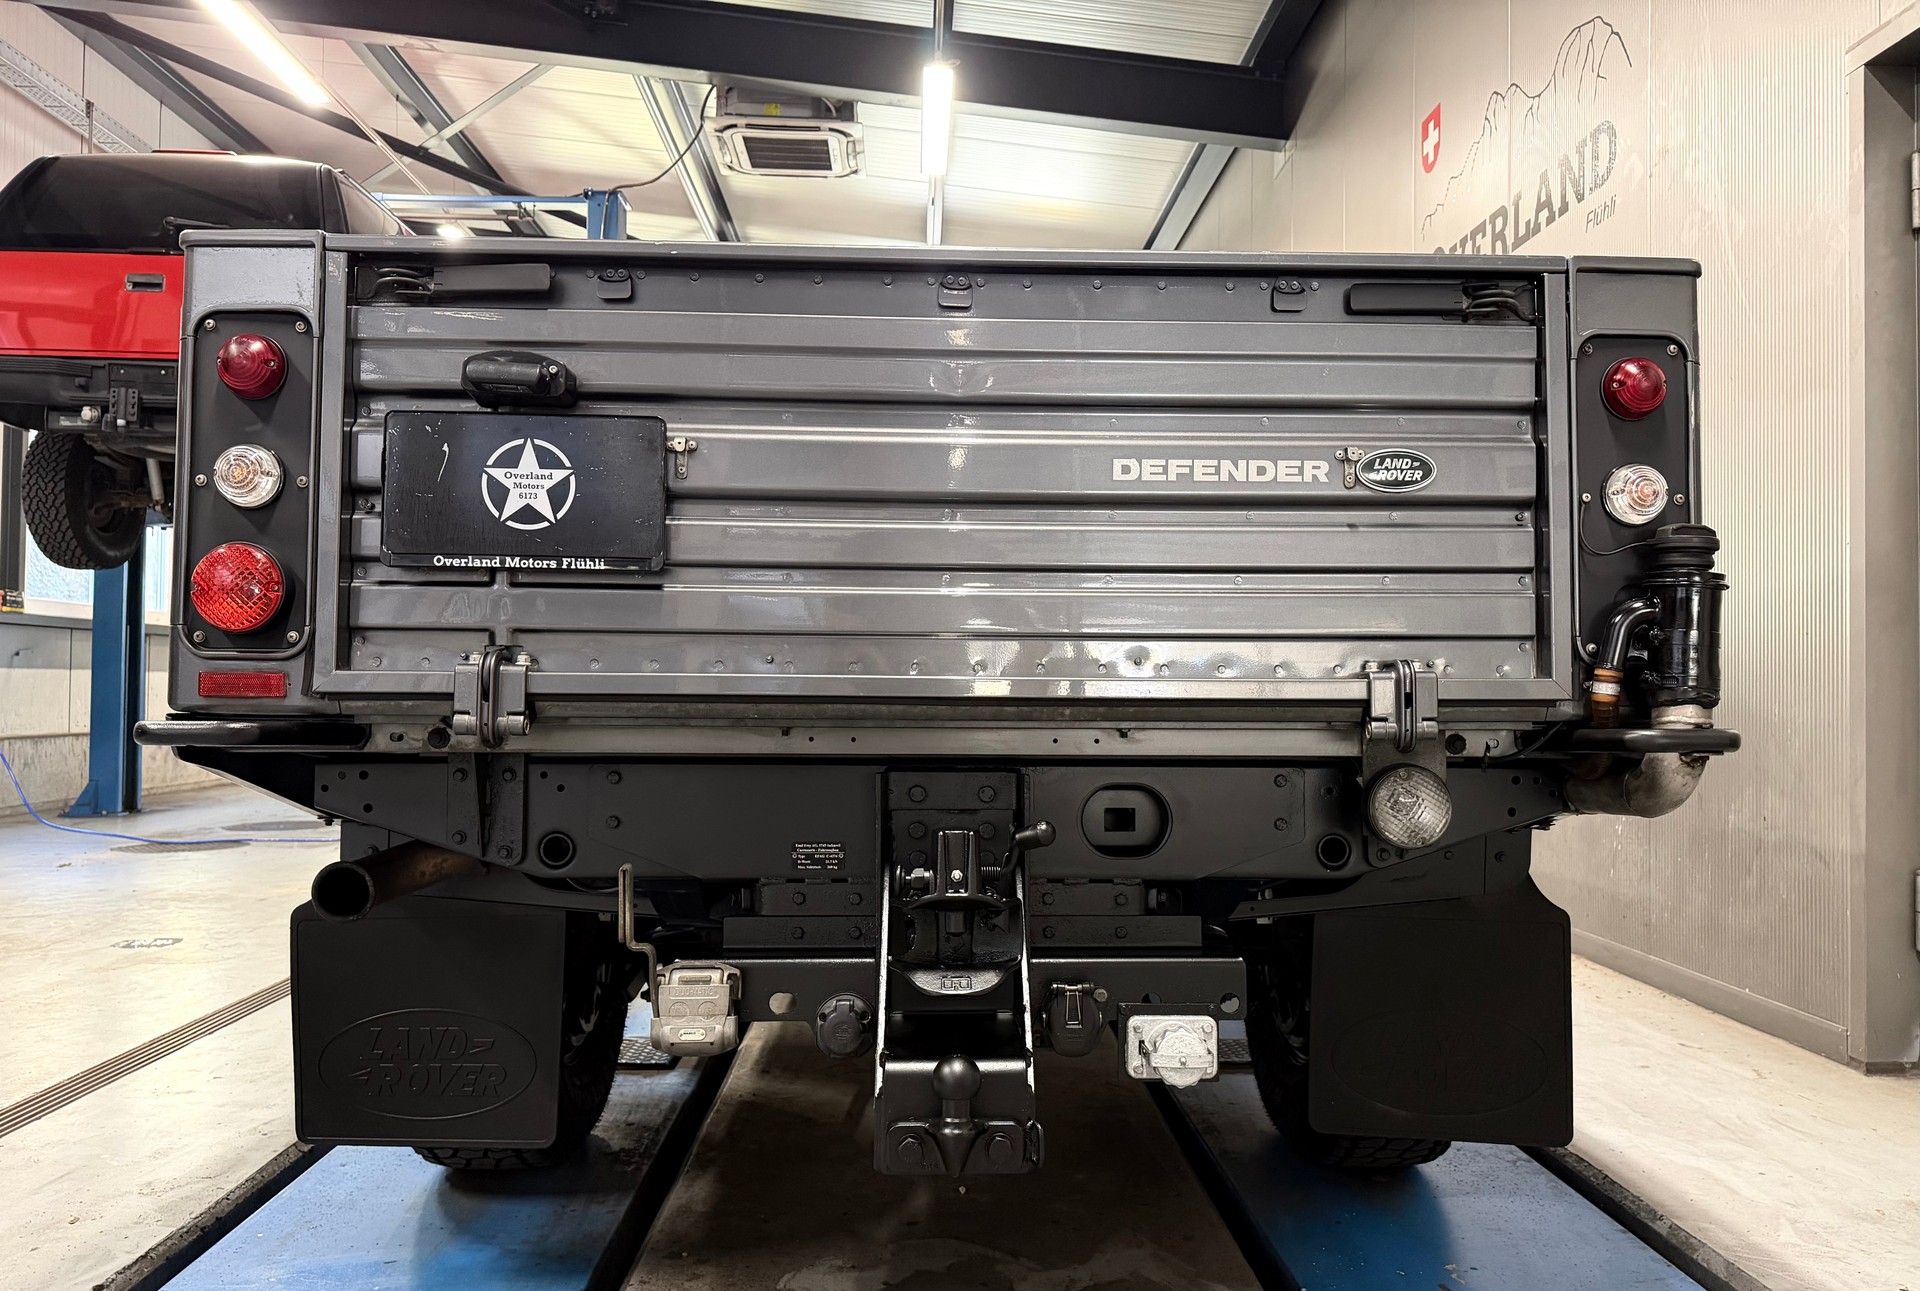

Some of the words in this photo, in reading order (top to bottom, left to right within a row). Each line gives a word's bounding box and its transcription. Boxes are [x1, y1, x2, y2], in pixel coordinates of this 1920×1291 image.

[1433, 119, 1618, 254] ERLAND
[1585, 193, 1617, 234] Flühli
[1112, 458, 1329, 482] DEFENDER
[1373, 458, 1412, 469] LAND
[503, 470, 554, 481] Overland
[1377, 469, 1423, 481] ROVER
[512, 482, 545, 491] Motors
[518, 492, 538, 500] 6173
[433, 555, 501, 568] Overland
[504, 557, 558, 570] Motors
[561, 557, 606, 570] Flühli
[359, 1027, 468, 1061] LAND
[366, 1063, 507, 1097] ROVER
